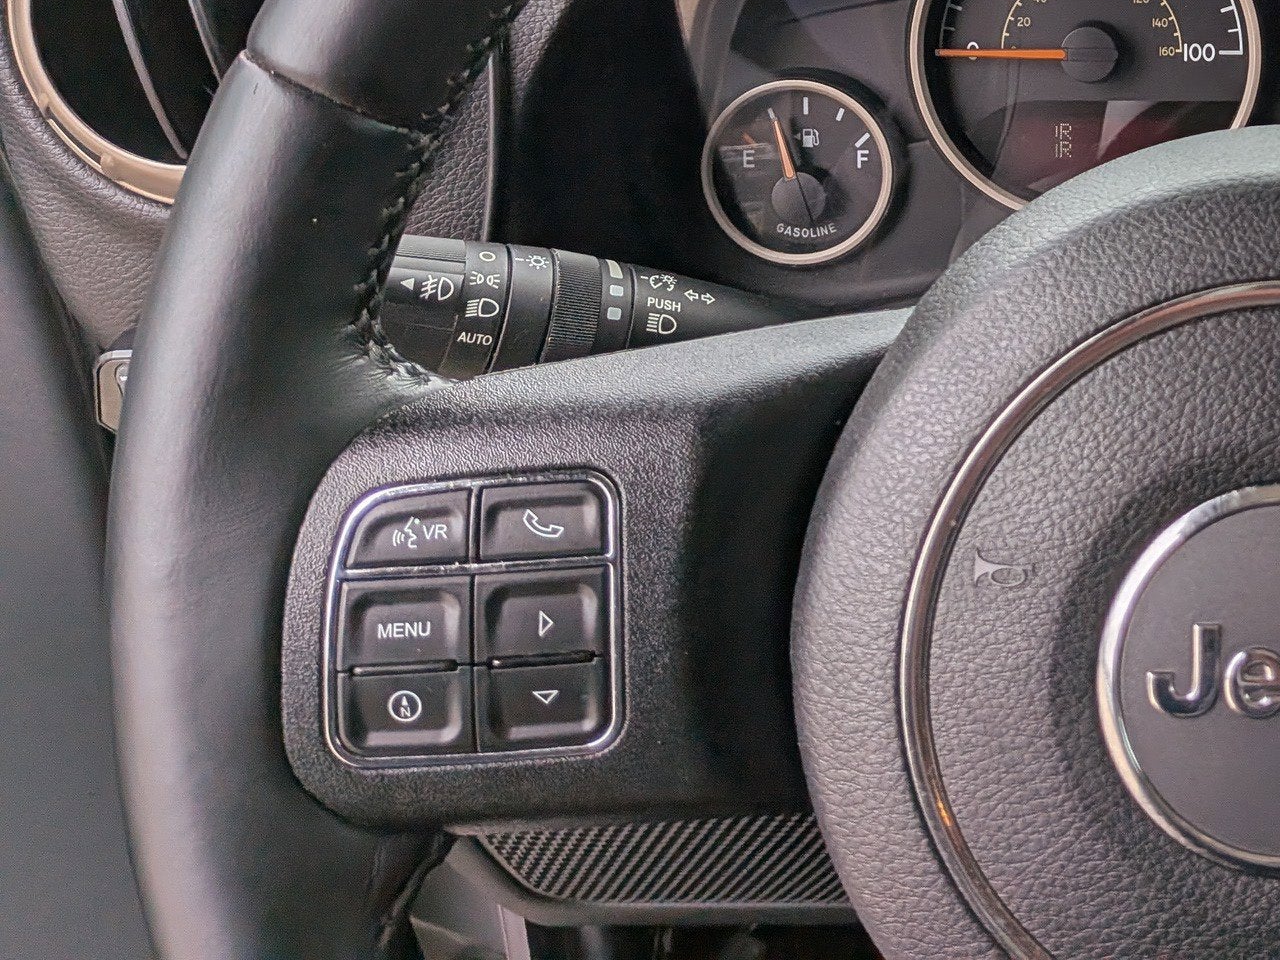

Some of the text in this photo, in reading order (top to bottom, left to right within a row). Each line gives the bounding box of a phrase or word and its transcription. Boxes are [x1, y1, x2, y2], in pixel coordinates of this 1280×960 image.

[1017, 16, 1031, 27] 20
[1152, 17, 1169, 28] 140
[1159, 46, 1176, 57] 160
[1183, 43, 1216, 62] 100
[742, 146, 756, 168] E
[856, 149, 870, 169] F
[776, 222, 837, 238] GASOLINE
[647, 296, 681, 313] PUSH
[456, 331, 493, 346] AUTO
[422, 523, 448, 540] VR
[377, 621, 431, 639] MENU
